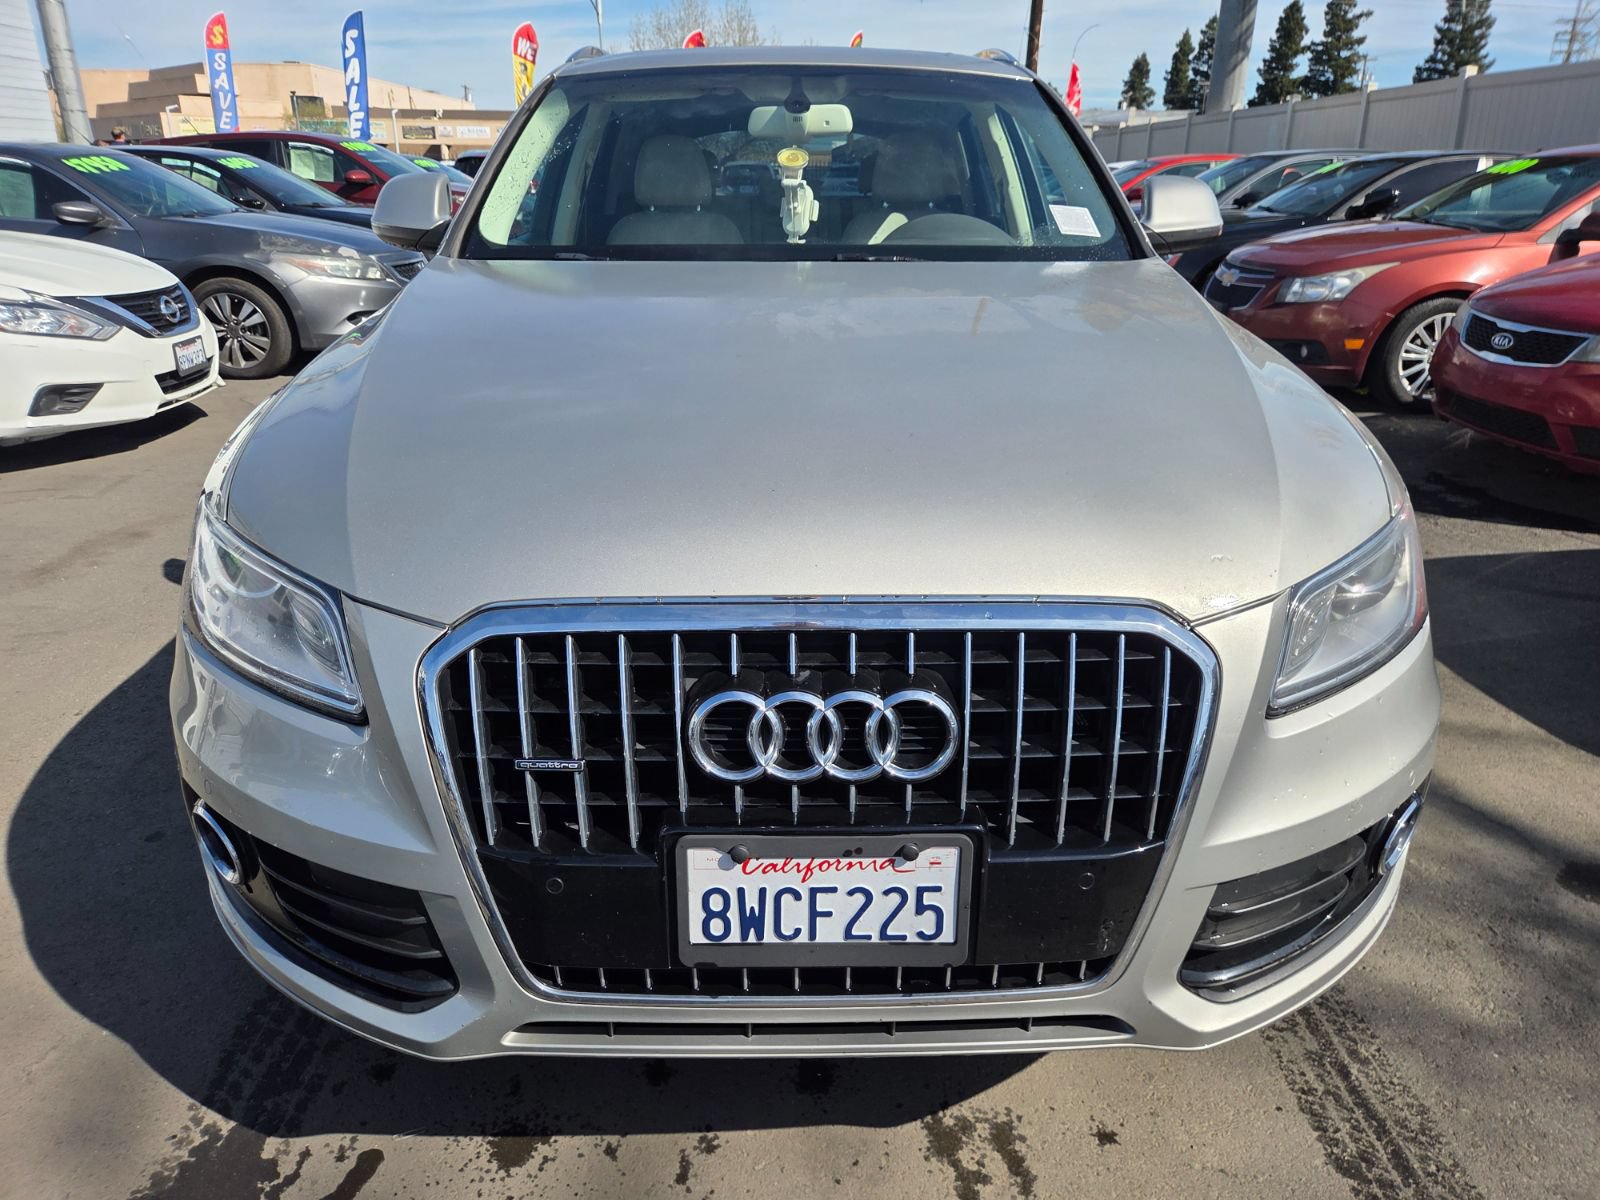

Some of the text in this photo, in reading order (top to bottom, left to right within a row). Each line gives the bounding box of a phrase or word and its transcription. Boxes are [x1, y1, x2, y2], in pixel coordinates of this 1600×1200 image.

[214, 52, 232, 129] SAVE
[345, 29, 365, 139] SALE
[519, 761, 579, 769] quattro
[742, 857, 916, 884] California
[701, 885, 946, 943] 8WCF225
